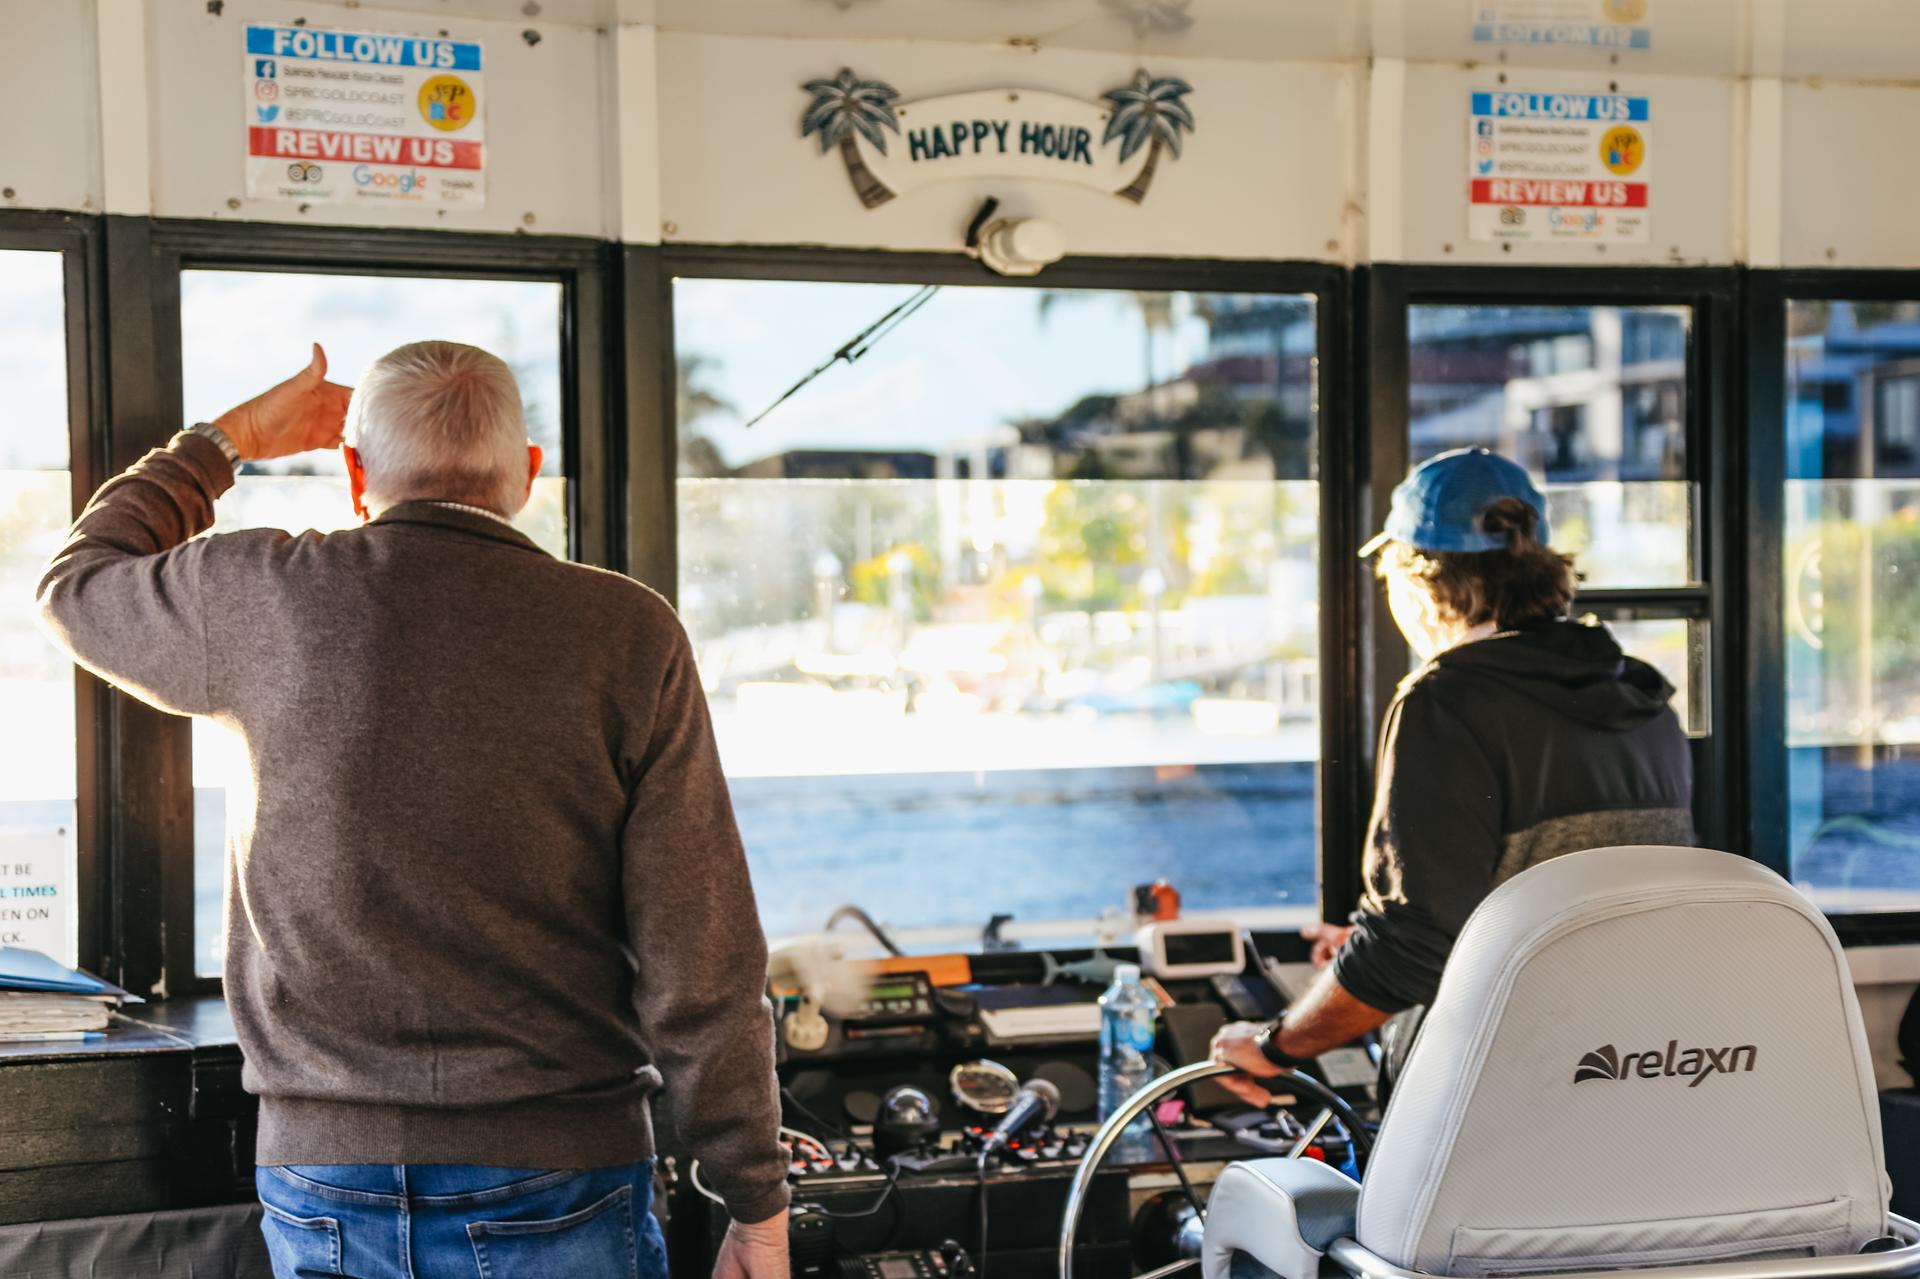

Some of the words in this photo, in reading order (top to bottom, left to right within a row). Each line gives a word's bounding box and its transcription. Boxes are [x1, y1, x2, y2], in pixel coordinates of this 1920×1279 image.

[273, 28, 403, 64] FOLLOW
[412, 43, 456, 68] US
[1490, 95, 1590, 119] FOLLOW
[1595, 97, 1631, 120] US
[275, 131, 402, 161] REVIEW
[411, 143, 455, 164] US
[907, 119, 1010, 163] HAPPY
[1019, 120, 1094, 166] HOUR
[352, 163, 427, 193] Google
[1490, 182, 1587, 204] REVIEW
[1592, 184, 1628, 205] US
[1549, 207, 1606, 231] Google
[15, 863, 32, 875] BE
[13, 885, 57, 898] TIMES
[27, 908, 49, 920] ON
[1619, 1039, 1758, 1088] relaxn
